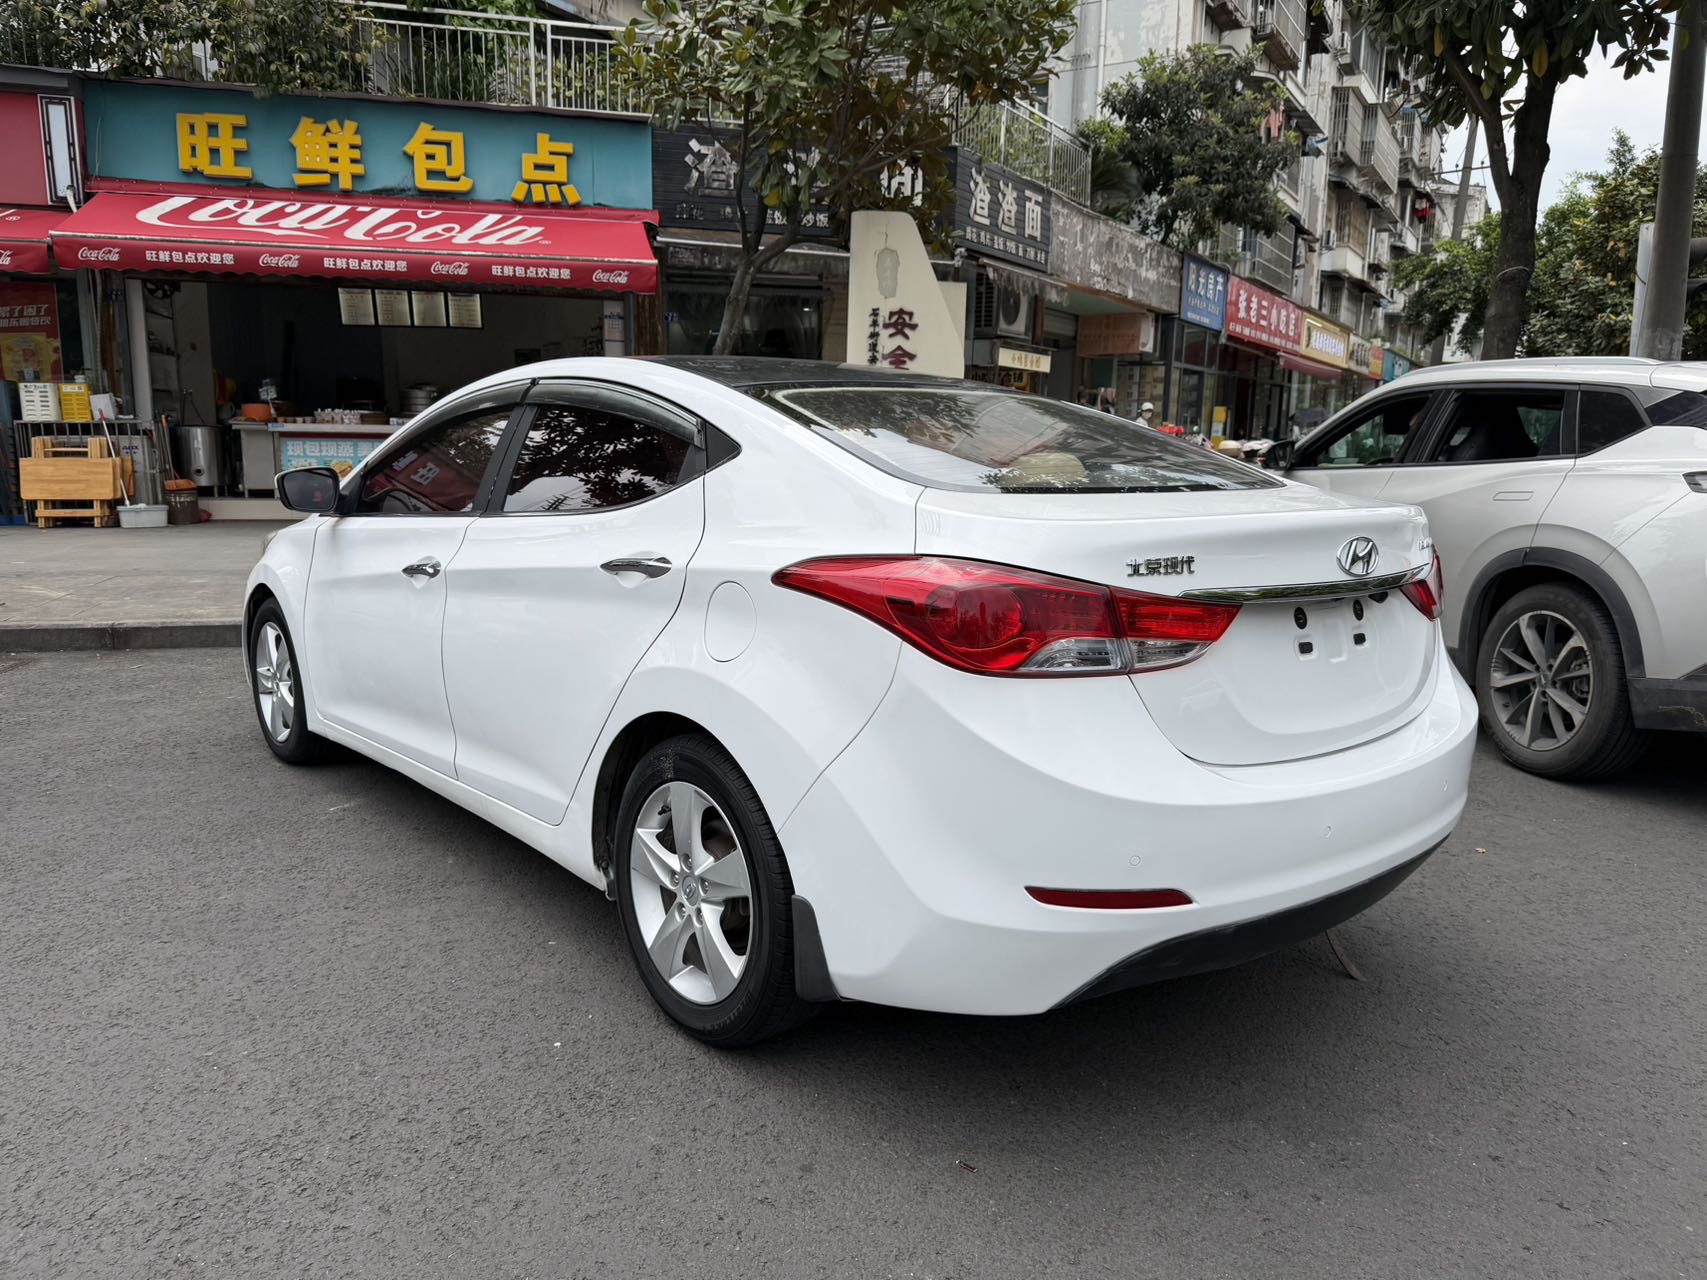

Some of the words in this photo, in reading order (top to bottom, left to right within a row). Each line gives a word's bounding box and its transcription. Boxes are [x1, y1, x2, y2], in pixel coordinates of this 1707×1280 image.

[176, 112, 581, 206] 旺鲜包点
[969, 167, 1042, 241] 渣渣面
[145, 250, 235, 265] 旺鲜包点欢迎您
[323, 257, 408, 272] 旺鲜包点欢迎您
[491, 265, 571, 279] 旺鲜包点欢迎您
[882, 307, 919, 371] 安全
[1126, 555, 1195, 577] 北京现代
